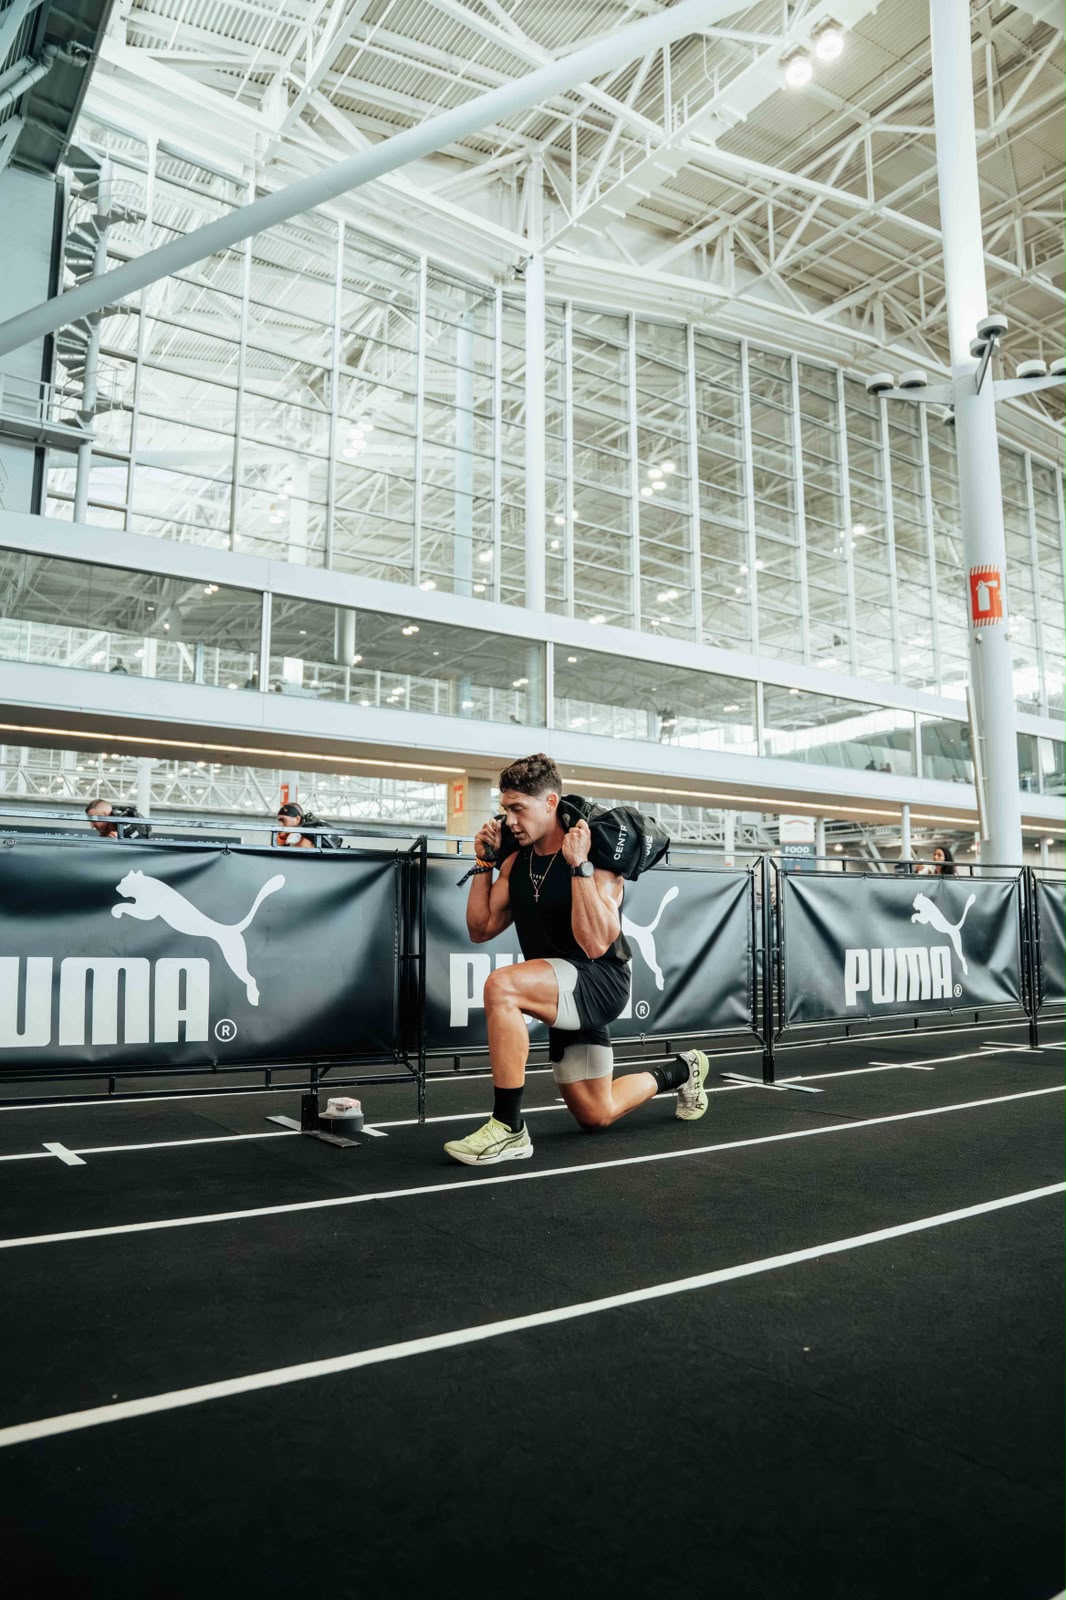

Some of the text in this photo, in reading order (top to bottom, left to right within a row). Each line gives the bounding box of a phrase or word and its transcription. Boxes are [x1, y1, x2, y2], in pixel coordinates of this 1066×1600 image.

[613, 825, 628, 860] CENTR
[784, 846, 810, 854] FOOD
[845, 946, 953, 1006] PUMA
